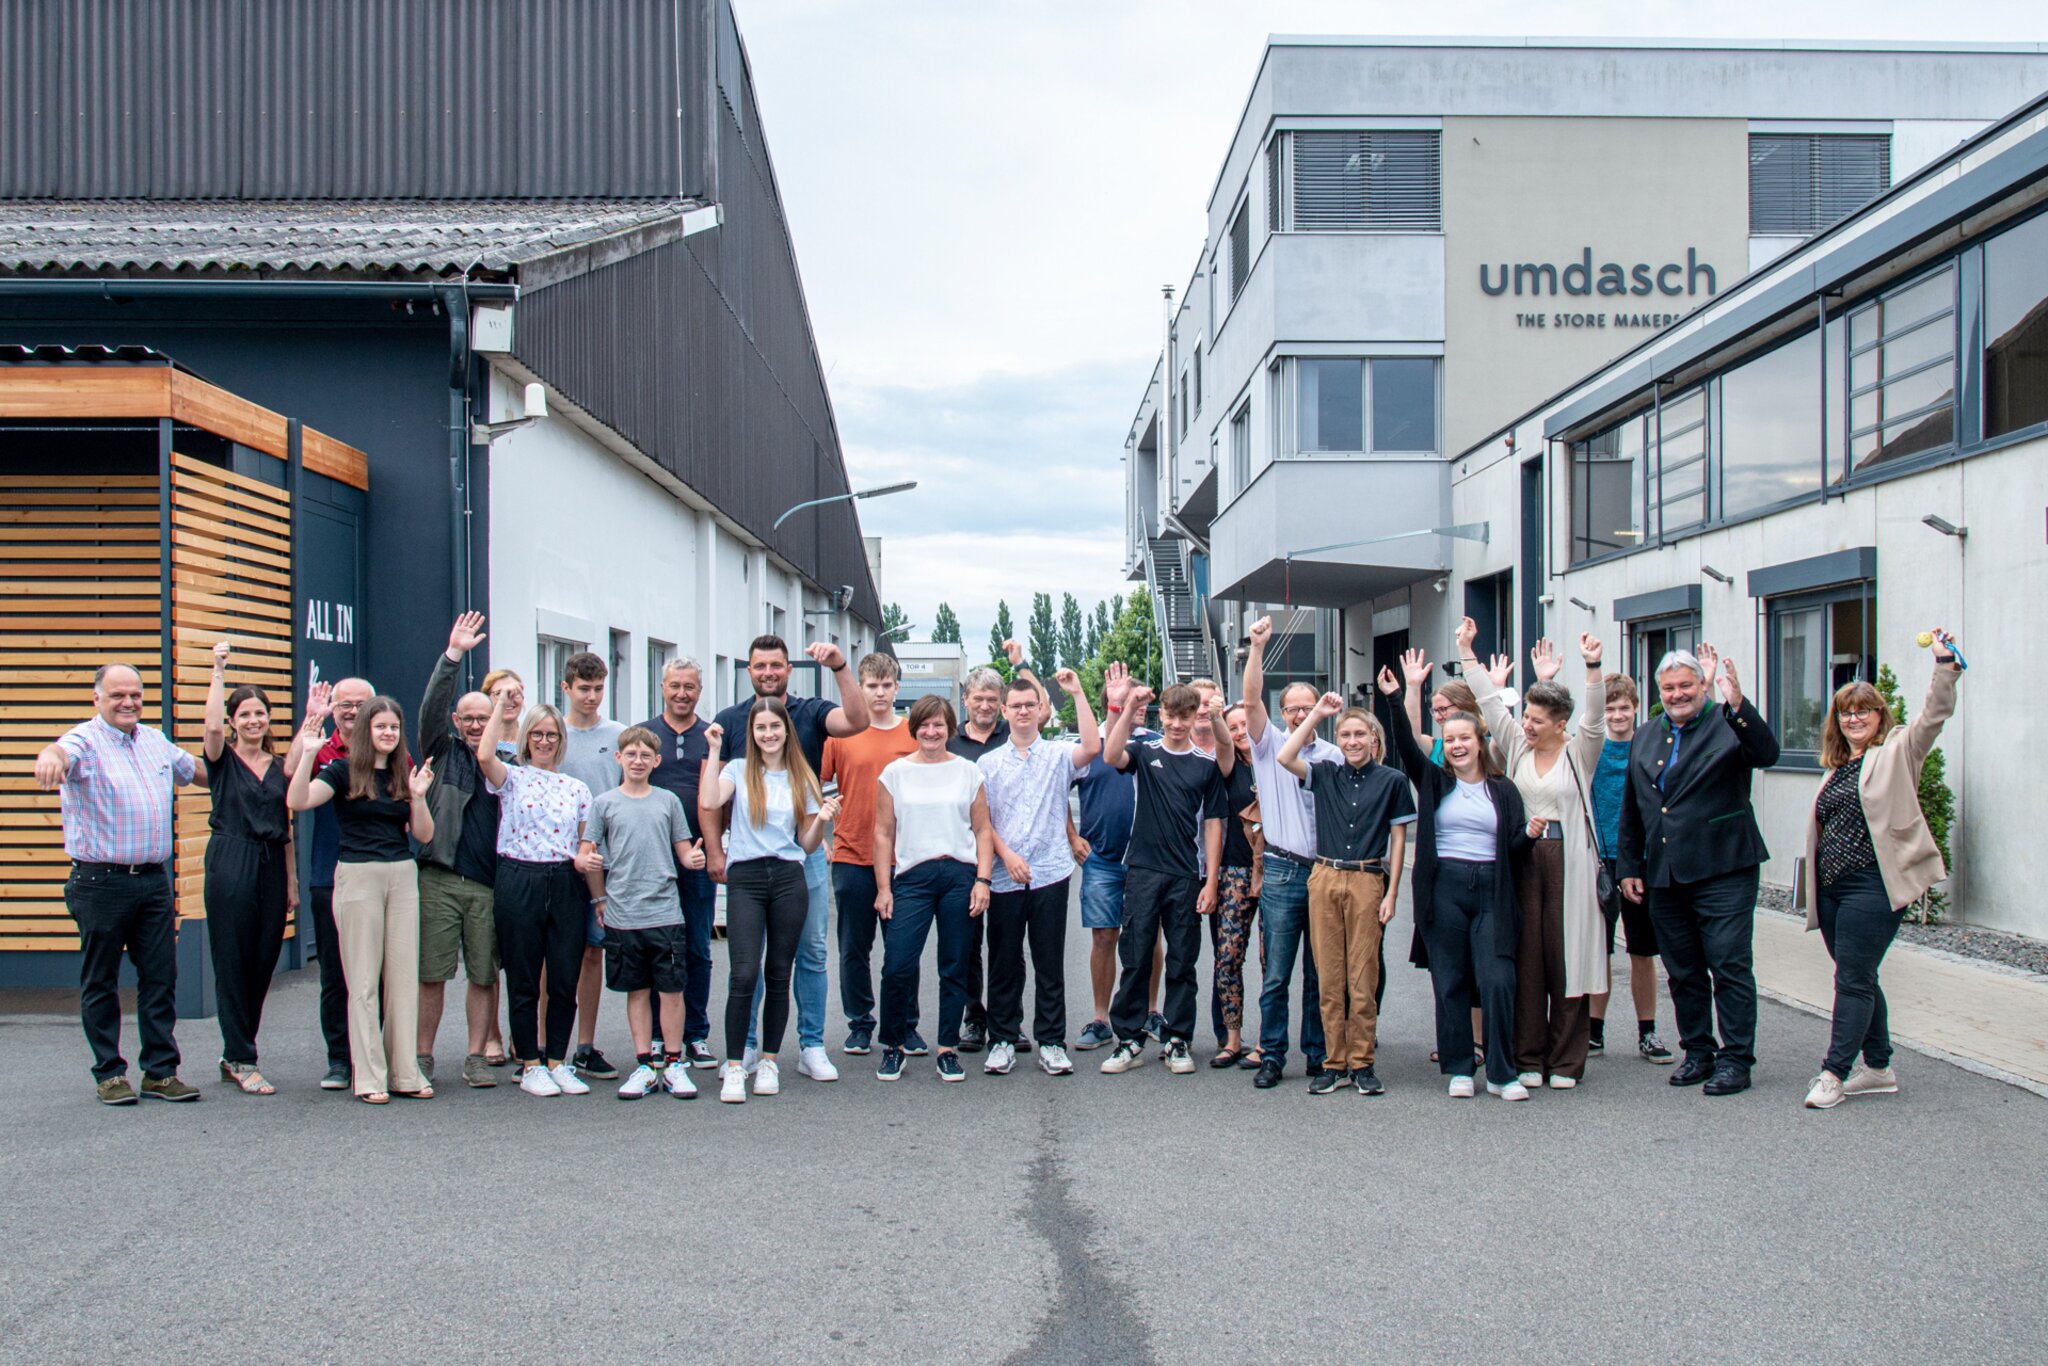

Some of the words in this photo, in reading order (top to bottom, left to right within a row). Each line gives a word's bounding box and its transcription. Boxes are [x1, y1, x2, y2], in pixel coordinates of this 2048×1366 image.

[1480, 247, 1716, 296] umdasch
[1516, 313, 1546, 327] THE
[1554, 313, 1606, 328] STORE
[306, 599, 333, 641] ALL
[336, 604, 353, 644] IN
